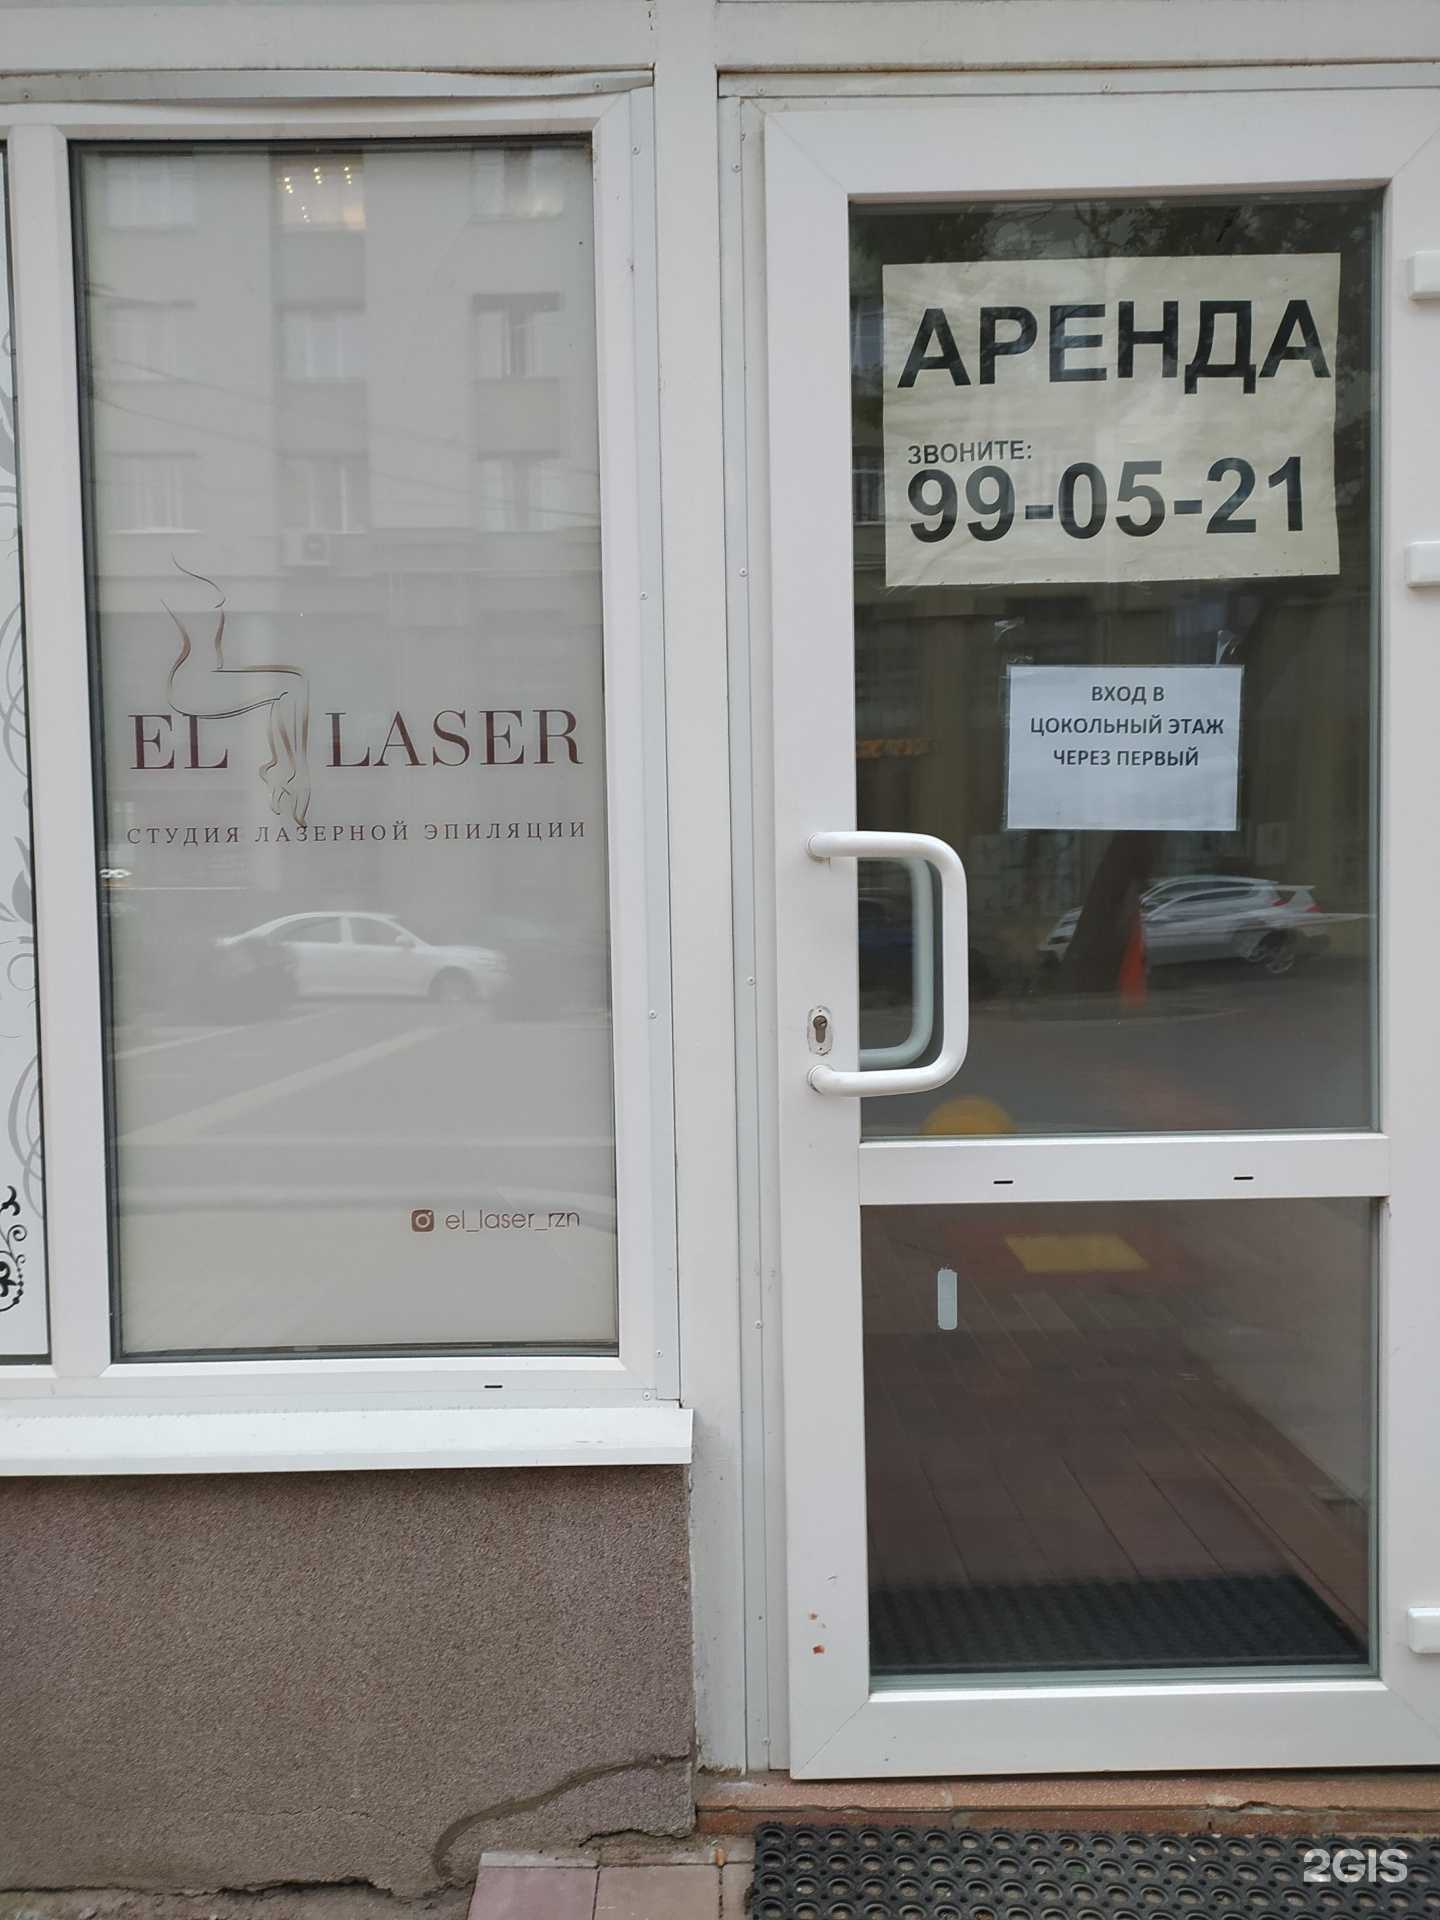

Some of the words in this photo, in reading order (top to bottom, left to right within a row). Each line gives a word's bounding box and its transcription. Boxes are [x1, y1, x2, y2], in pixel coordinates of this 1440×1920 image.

[897, 299, 1332, 395] АРЕНДА
[907, 440, 1033, 465] ЗВОНИТЕ:
[907, 455, 1304, 544] 99-05-21
[1091, 686, 1147, 705] ВХОД
[1153, 686, 1165, 702] В
[1030, 714, 1162, 736] ЦОКОЛЬНЫЙ
[1168, 718, 1224, 735] ЭТАЖ
[128, 712, 228, 770] EL
[325, 708, 584, 768] LASER
[1054, 749, 1111, 766] ЧЕРЕЗ
[1117, 746, 1199, 767] ПЕРВЫЙ
[127, 826, 241, 847] СТУДИЯ
[254, 820, 409, 845] ЛАЗЕРНОЙ
[424, 820, 587, 846] ЭПИЛЯЦИИ
[445, 1208, 580, 1233] el_laser_rzn
